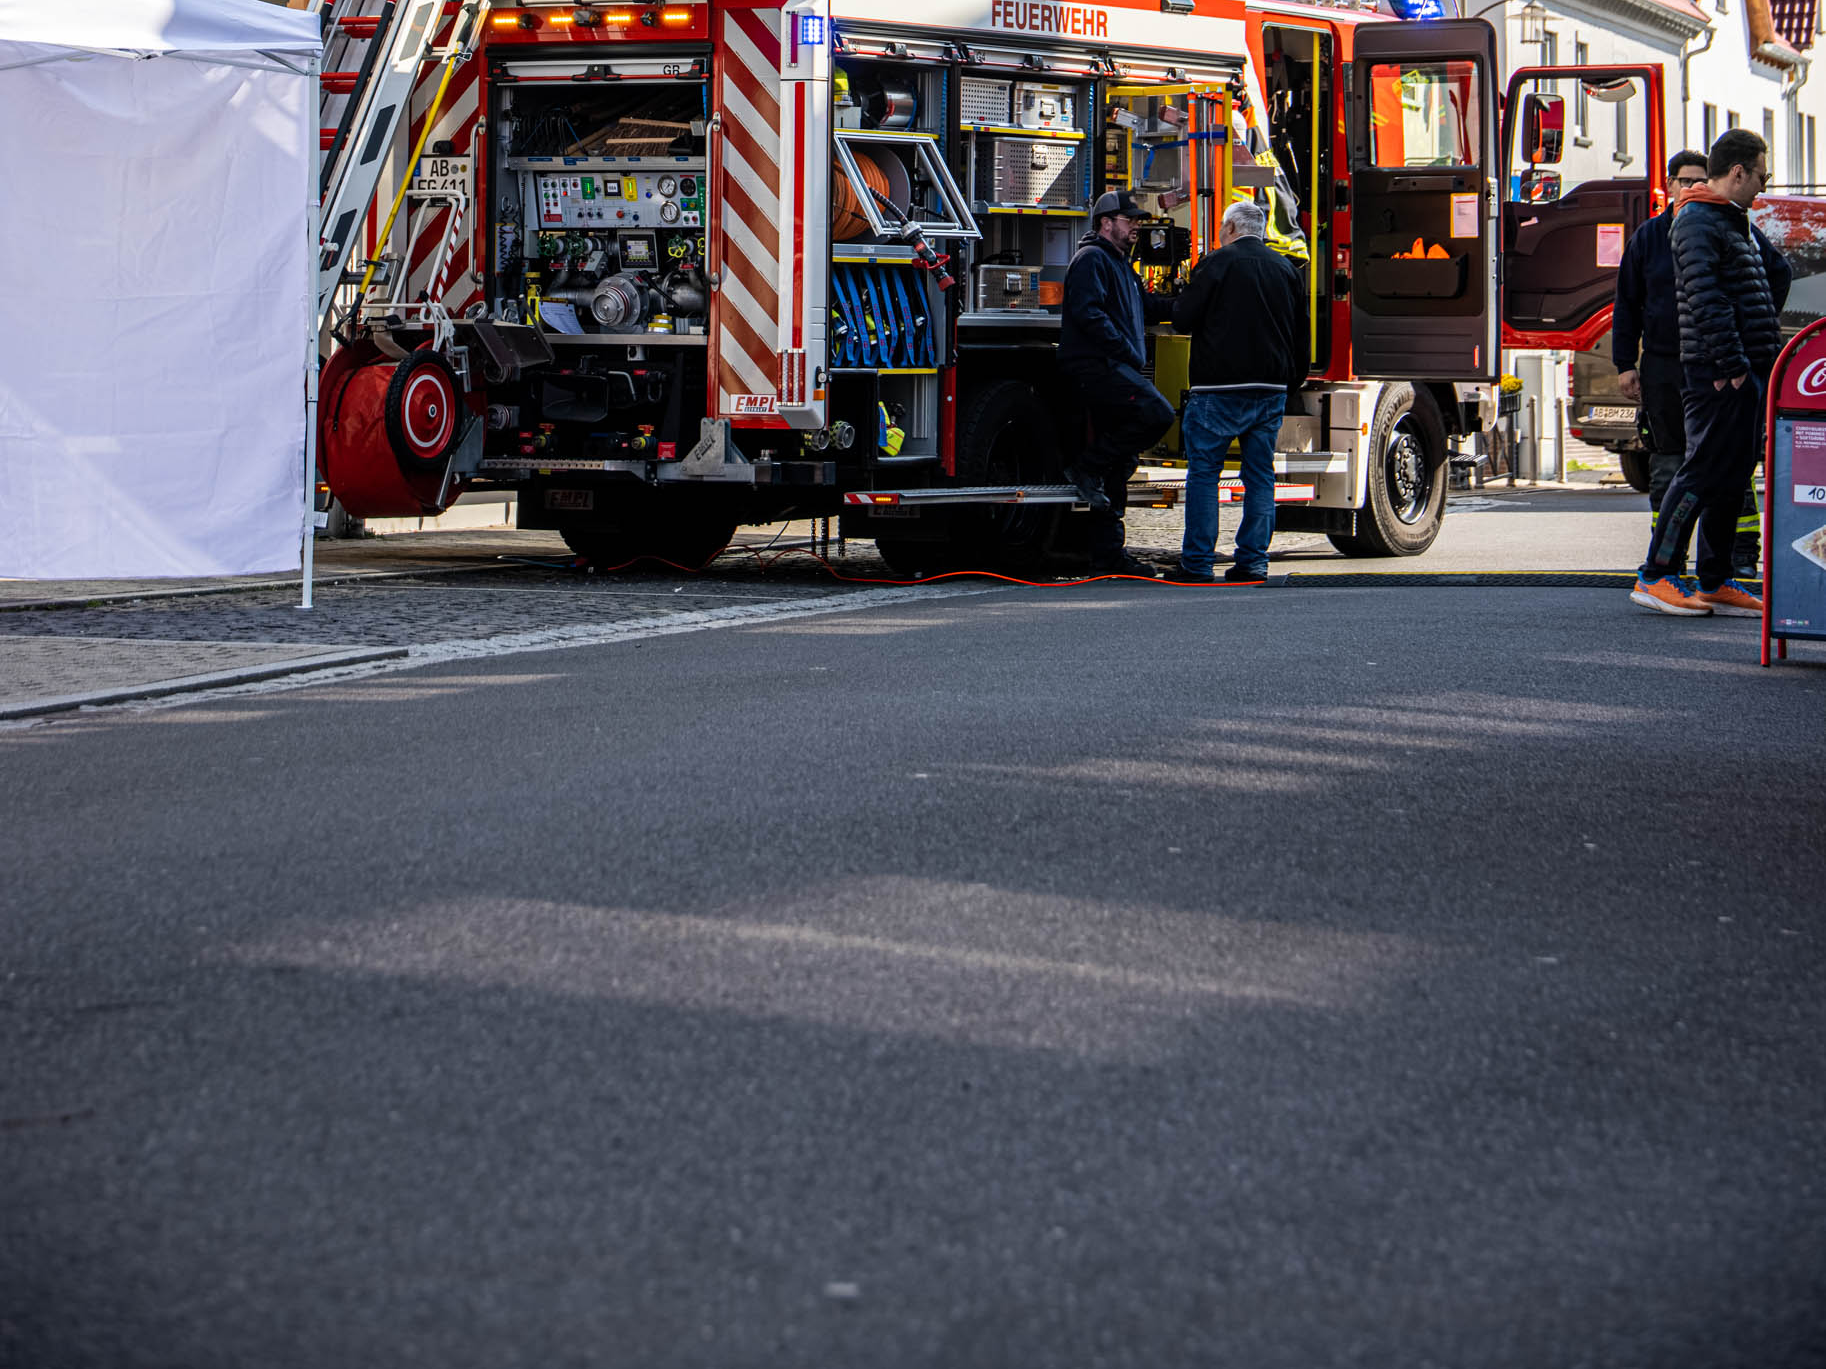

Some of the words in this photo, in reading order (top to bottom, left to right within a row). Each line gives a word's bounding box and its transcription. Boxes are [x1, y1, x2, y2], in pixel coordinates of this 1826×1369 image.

[991, 0, 1108, 38] FEUERWEHR
[430, 159, 450, 177] AB
[735, 396, 775, 413] EMPL
